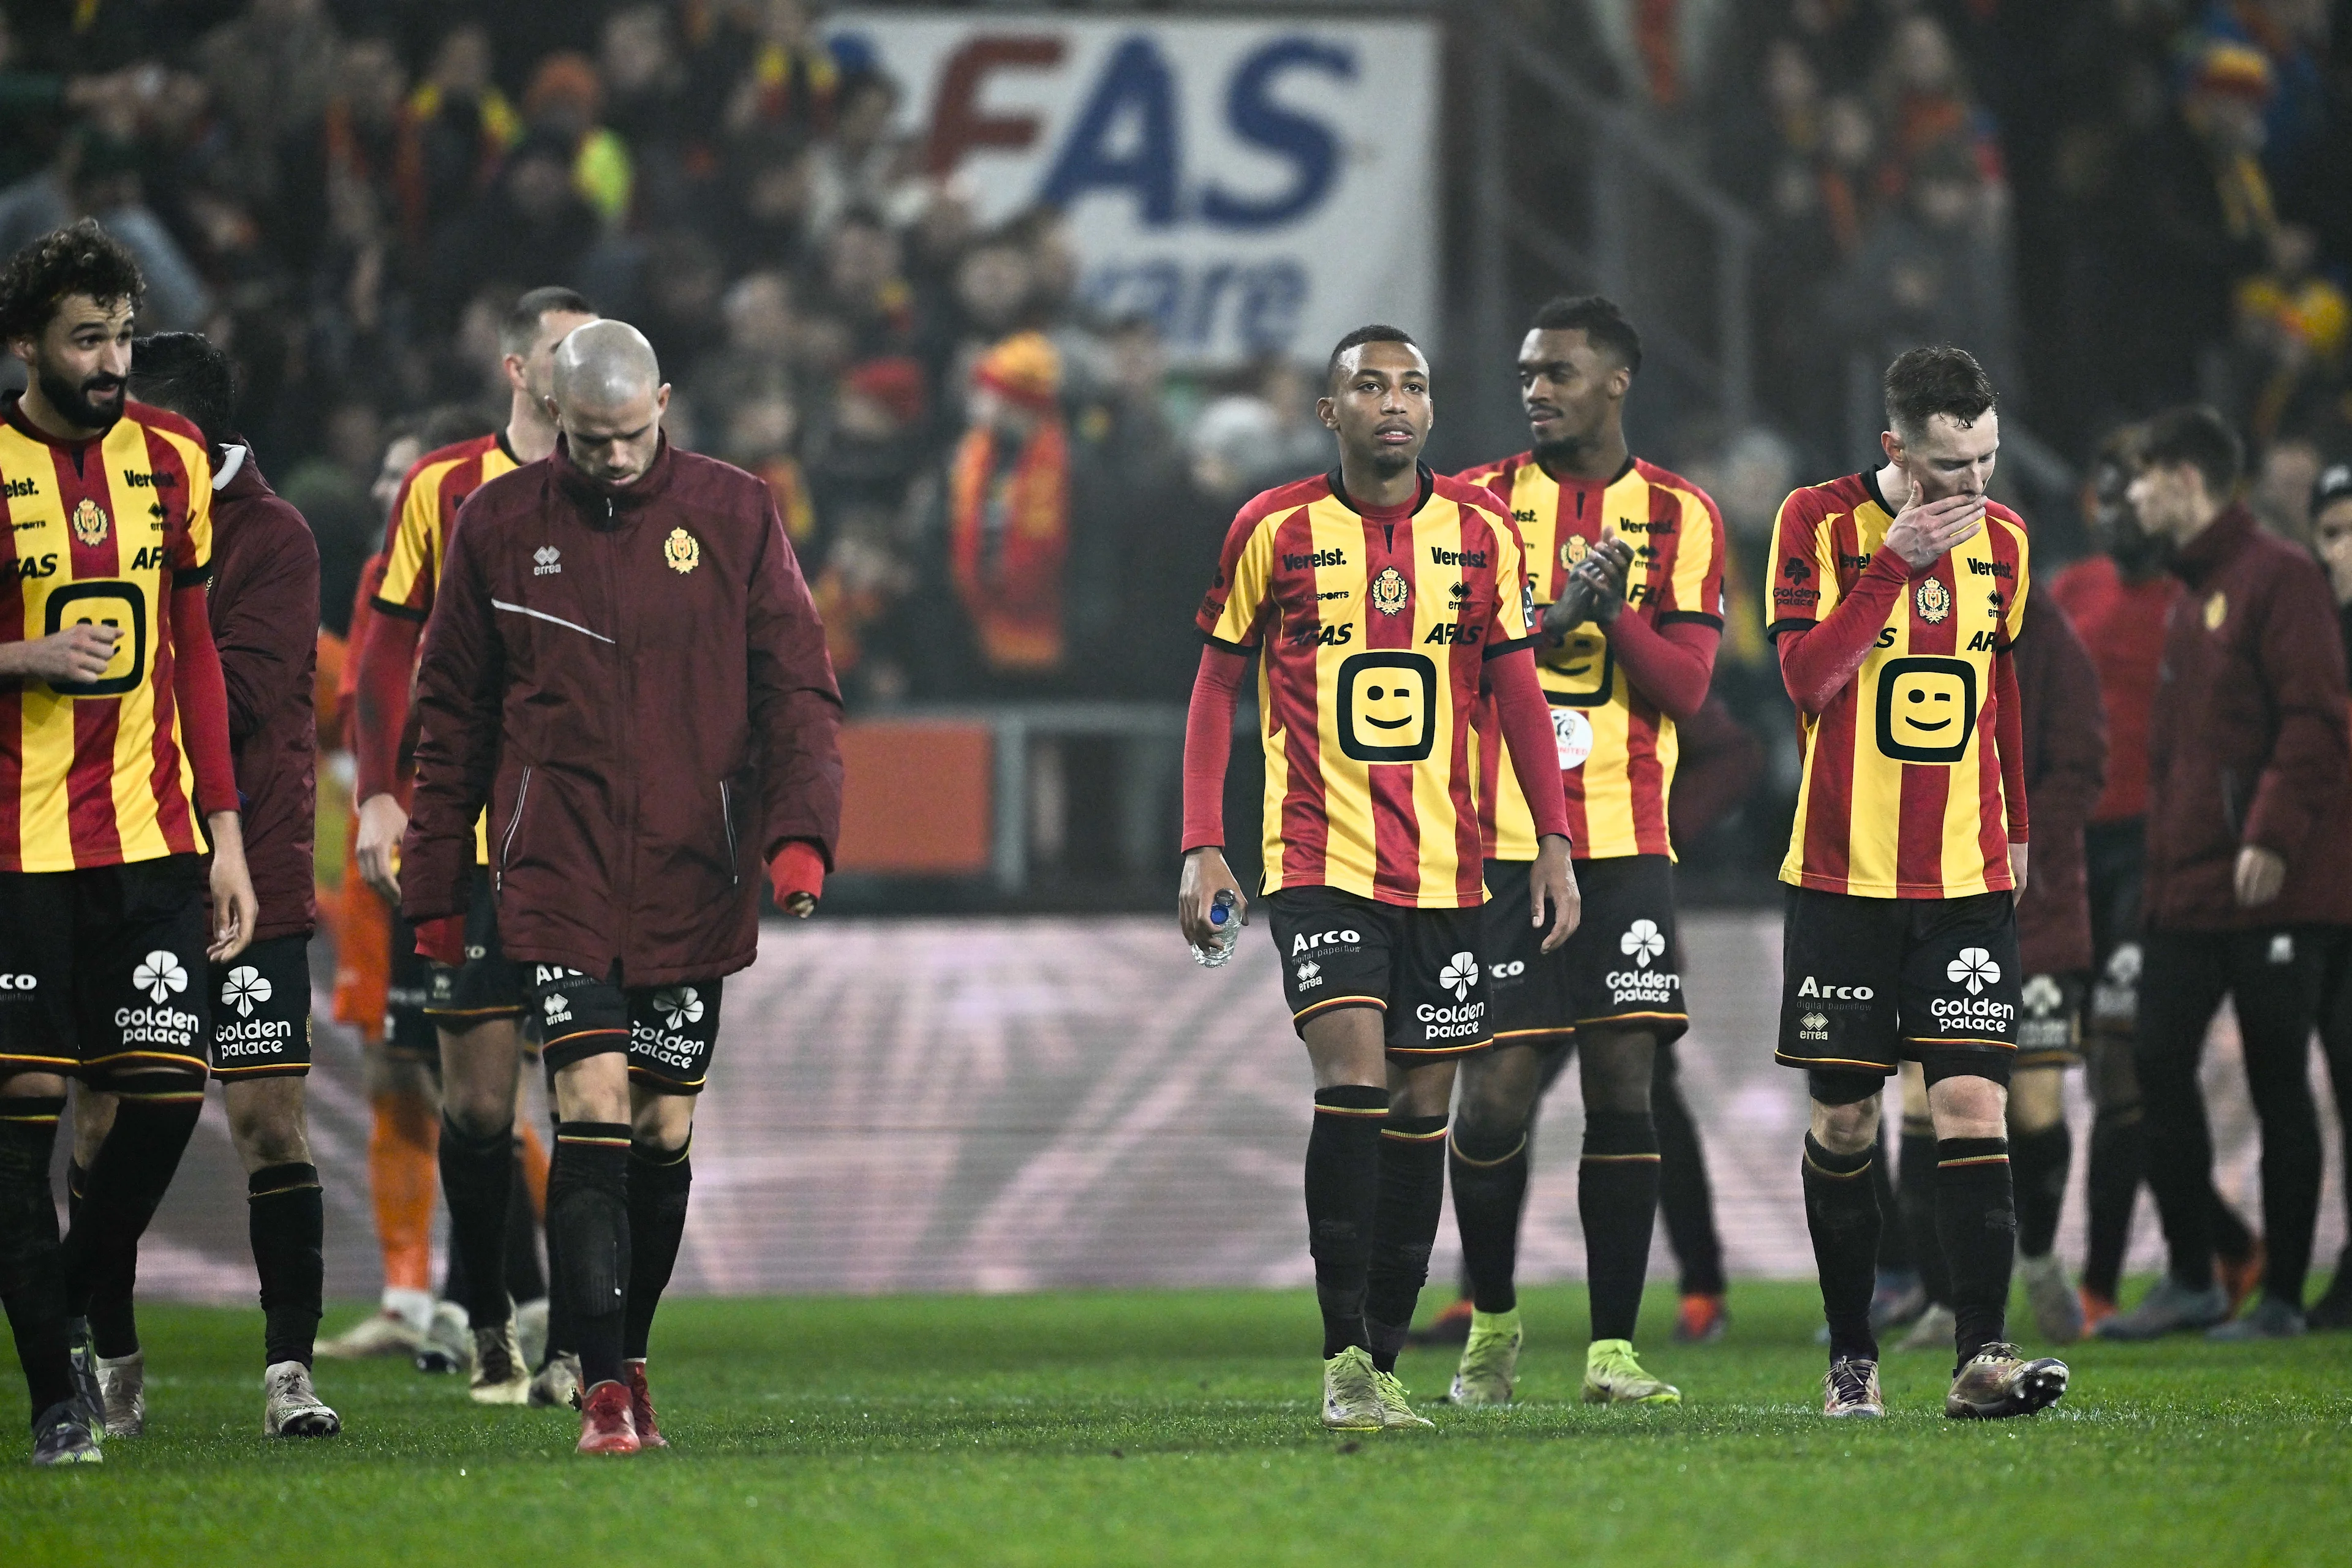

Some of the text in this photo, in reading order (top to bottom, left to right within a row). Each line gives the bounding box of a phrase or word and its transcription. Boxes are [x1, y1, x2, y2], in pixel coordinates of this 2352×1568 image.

[824, 34, 1361, 232] FAS
[1283, 548, 1347, 571] Verelst.
[1431, 546, 1487, 568] Verelst.
[533, 564, 562, 576] errea
[1967, 558, 2013, 580] Verelst.
[1773, 587, 1821, 600] Golden
[1776, 597, 1814, 608] palace
[1424, 623, 1483, 645] AFAS
[1292, 930, 1360, 957] Arco
[1291, 944, 1361, 966] digital paperflow
[1488, 960, 1525, 978] co
[1606, 969, 1679, 989] Golden
[0, 973, 37, 990] co
[1298, 976, 1322, 992] errea
[1798, 976, 1874, 1000] Arco
[1613, 987, 1670, 1005] palace
[1796, 1001, 1872, 1011] digital paperflow
[1416, 1001, 1485, 1023] Golden
[1931, 998, 2014, 1020] Golden
[115, 1006, 199, 1034] Golden
[1425, 1020, 1479, 1040] palace
[1939, 1016, 2007, 1033] palace
[123, 1026, 191, 1047] palace
[216, 1019, 291, 1042] Golden
[1800, 1030, 1828, 1040] errea
[221, 1040, 283, 1060] palace
